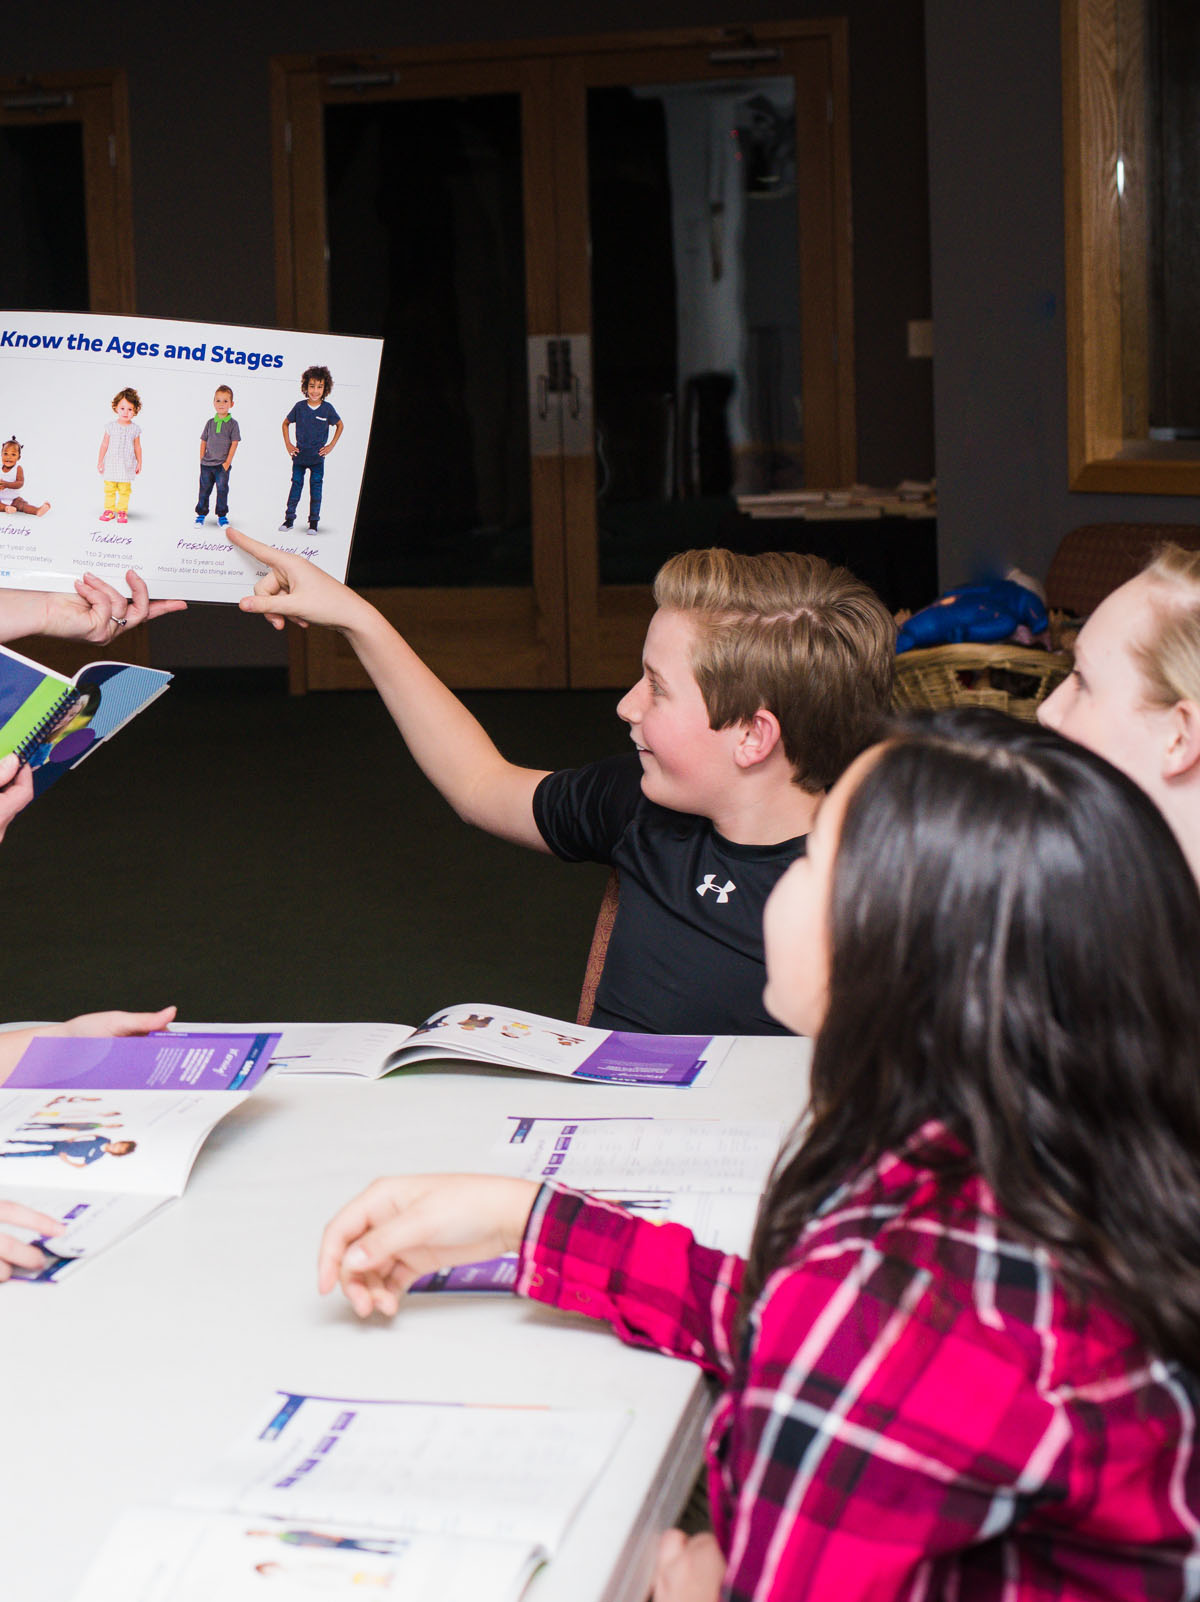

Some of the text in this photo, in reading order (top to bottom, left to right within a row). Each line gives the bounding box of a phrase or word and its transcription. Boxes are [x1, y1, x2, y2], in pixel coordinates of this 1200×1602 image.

[0, 330, 284, 371] Know the Ages and Stages
[89, 531, 133, 545] Toddlers
[176, 538, 235, 552] Preschoolers
[300, 546, 319, 561] Age
[72, 559, 95, 567] Mostly
[95, 560, 120, 569] depend
[157, 566, 178, 574] Mostly
[208, 568, 227, 576] things
